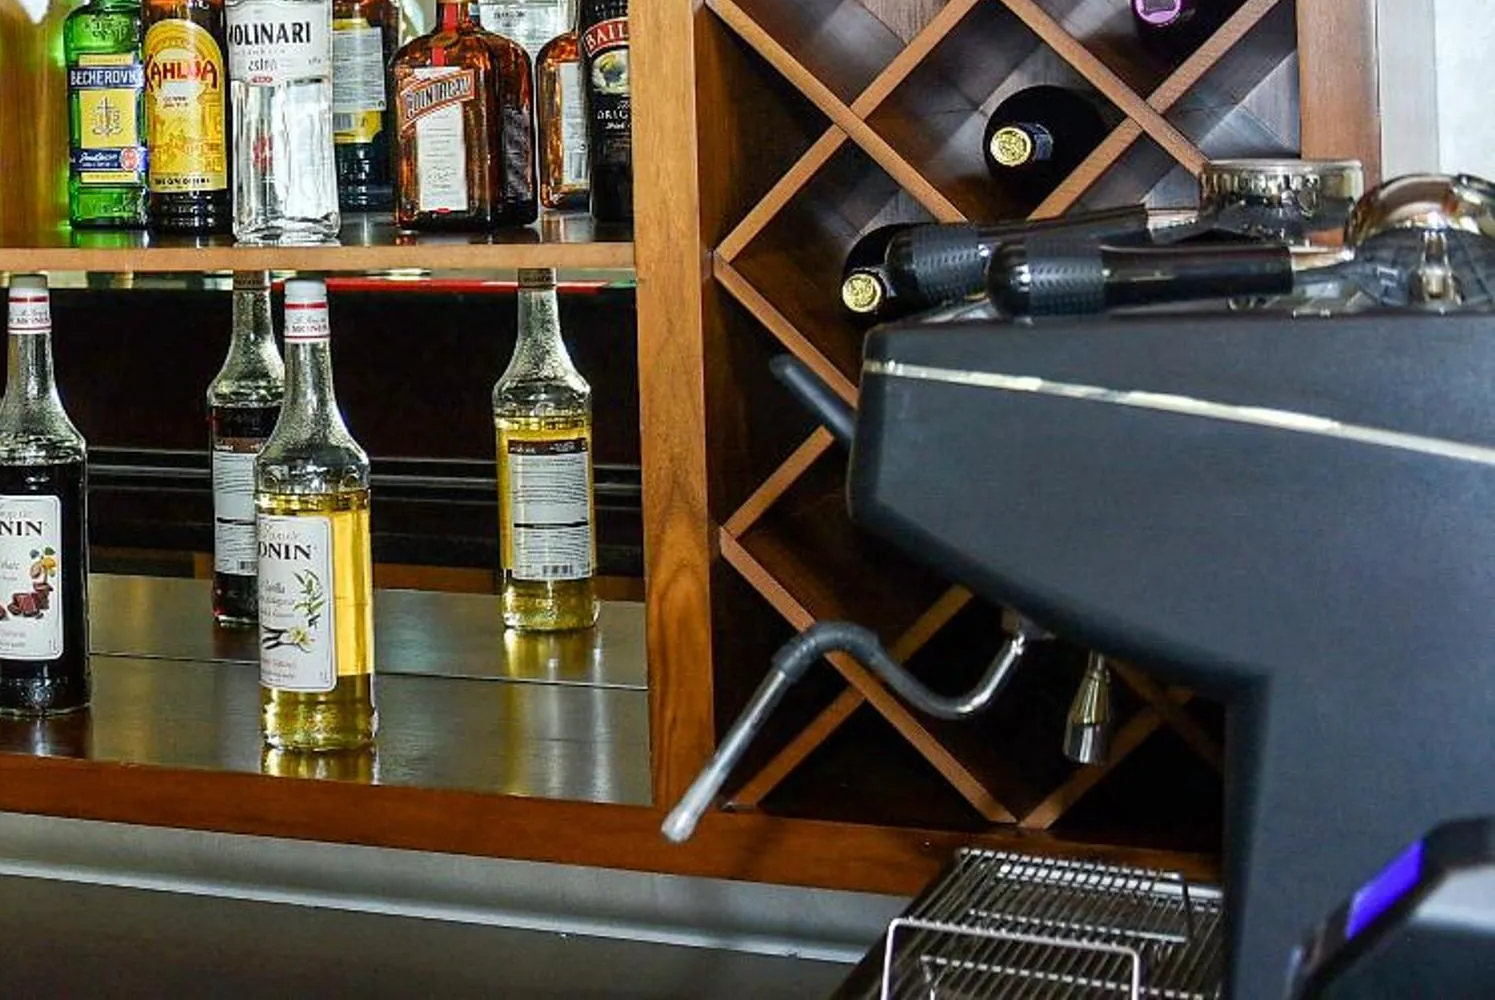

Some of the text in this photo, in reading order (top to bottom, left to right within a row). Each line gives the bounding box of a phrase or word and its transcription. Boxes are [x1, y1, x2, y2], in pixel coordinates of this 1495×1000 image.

[585, 23, 628, 51] BAIL
[70, 69, 138, 86] BECHEROVK
[258, 541, 311, 560] ONIN
